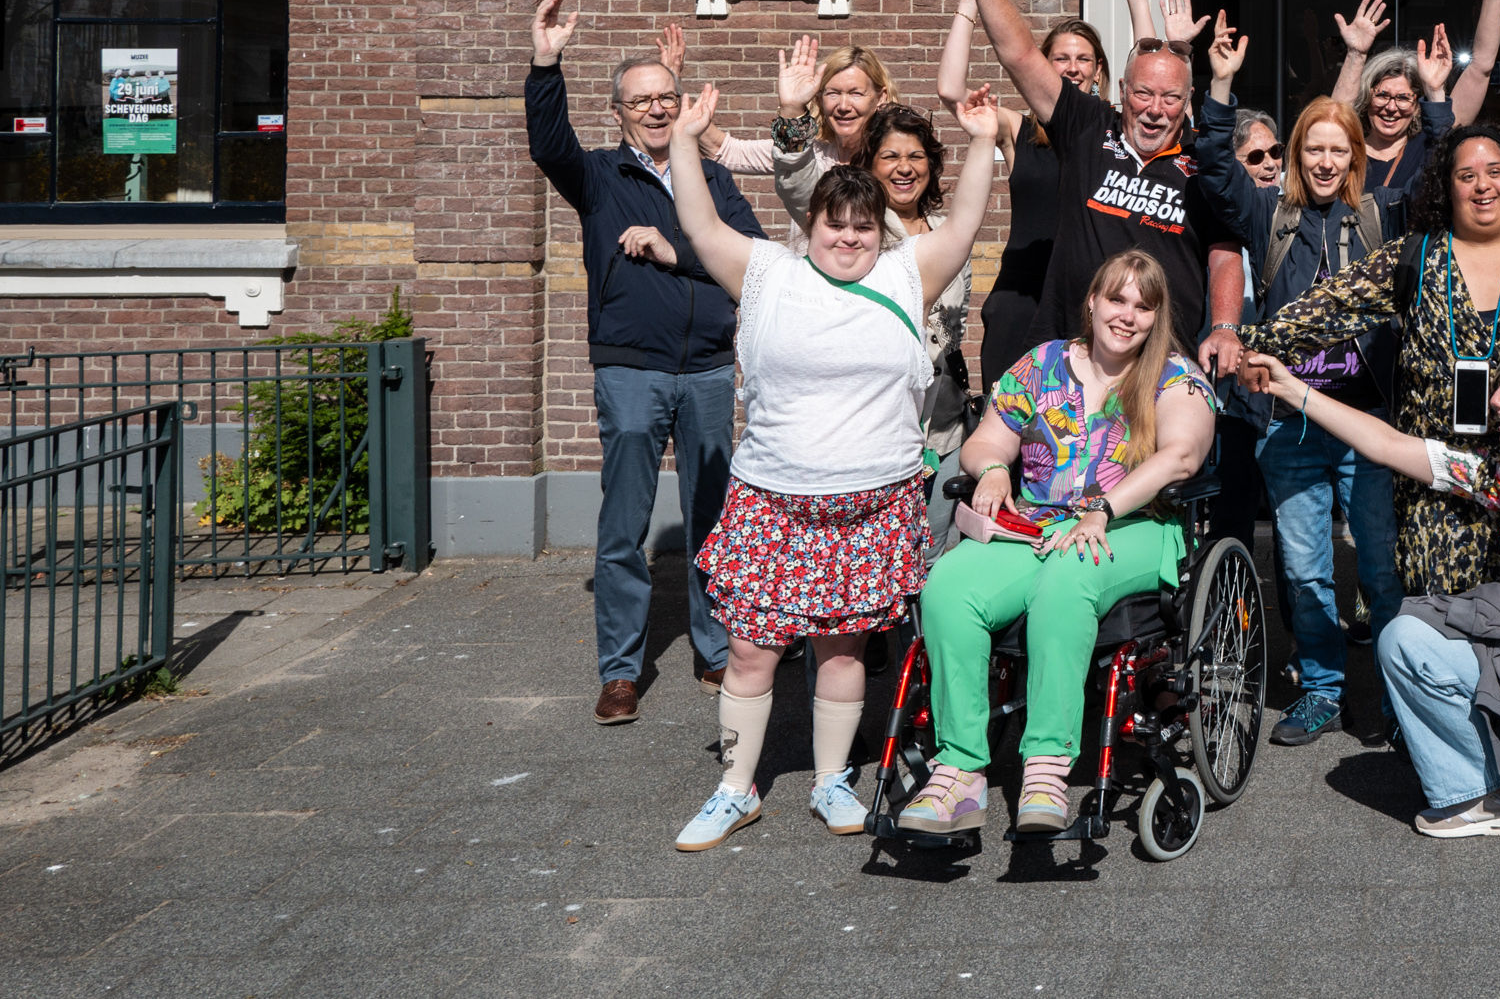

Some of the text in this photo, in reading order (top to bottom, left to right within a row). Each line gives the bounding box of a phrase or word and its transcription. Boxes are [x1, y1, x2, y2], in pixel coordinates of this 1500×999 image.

[117, 82, 159, 98] 29 juni
[105, 104, 174, 114] SCHEVENINGSE
[129, 114, 149, 122] DAG
[1093, 187, 1186, 224] DAVIDSON
[1140, 215, 1170, 233] Racing
